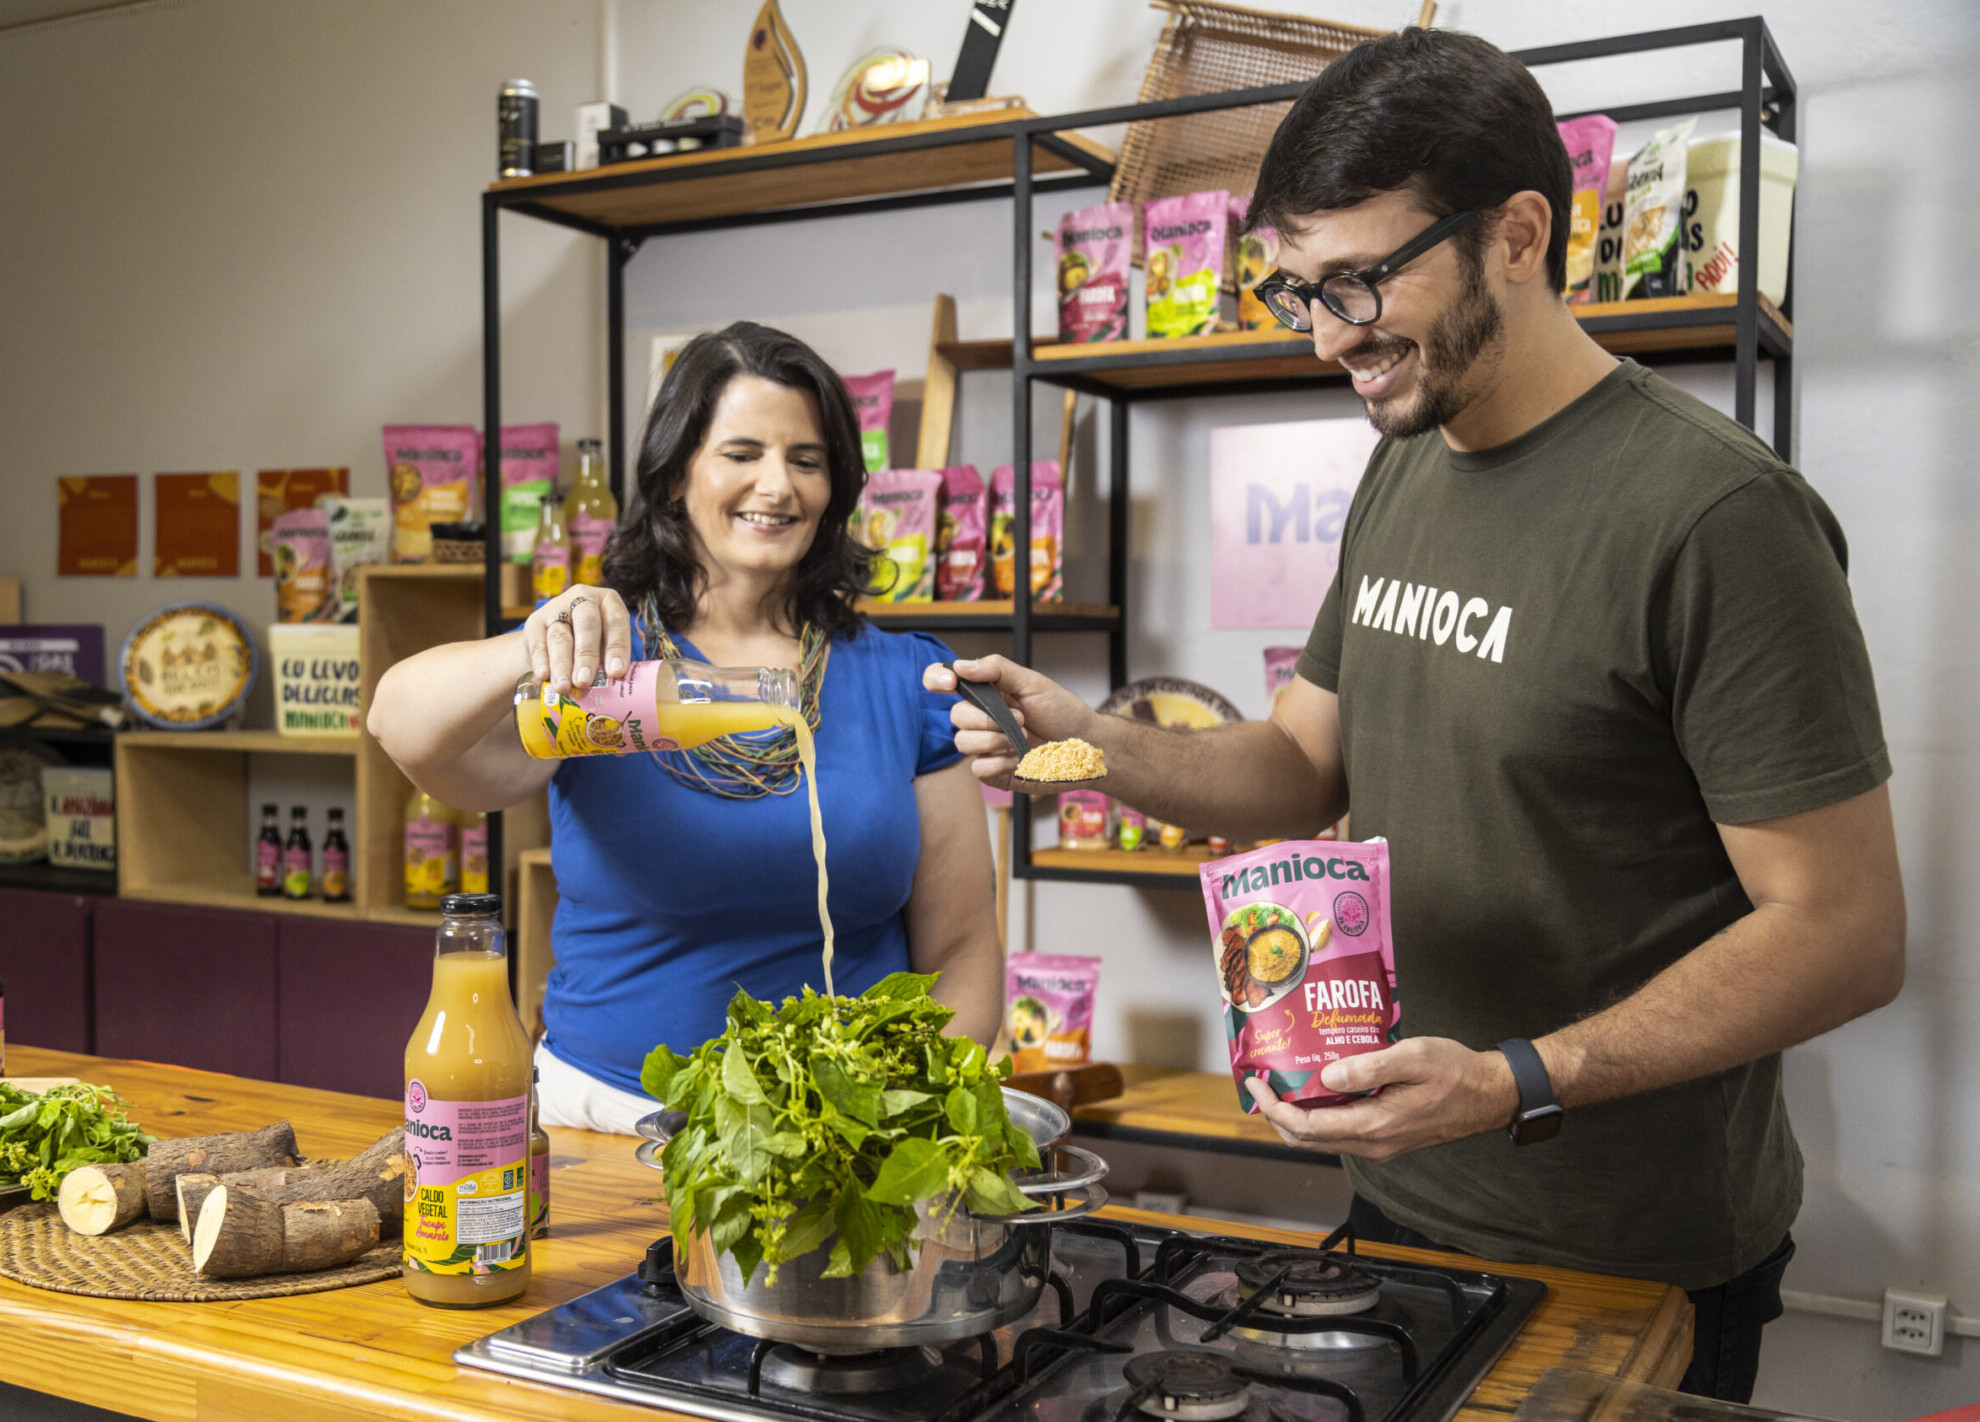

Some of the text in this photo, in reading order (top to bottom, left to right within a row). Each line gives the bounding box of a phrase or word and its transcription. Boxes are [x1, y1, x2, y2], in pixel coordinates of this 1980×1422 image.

[1352, 574, 1513, 664] MANIOCA
[311, 659, 359, 682] LEVO
[1222, 853, 1370, 900] Manioca
[1304, 979, 1384, 1012] FAROFA
[1311, 1008, 1383, 1030] Defumada
[1254, 1028, 1283, 1045] Super
[1318, 1026, 1346, 1036] tempero
[1346, 1025, 1369, 1034] caseiro
[1325, 1034, 1380, 1046] ALHO E CEBOLA
[1249, 1037, 1292, 1059] crocante!
[1295, 1055, 1311, 1065] Peso
[420, 1187, 444, 1204] CALDO
[417, 1201, 449, 1219] VEGETAL
